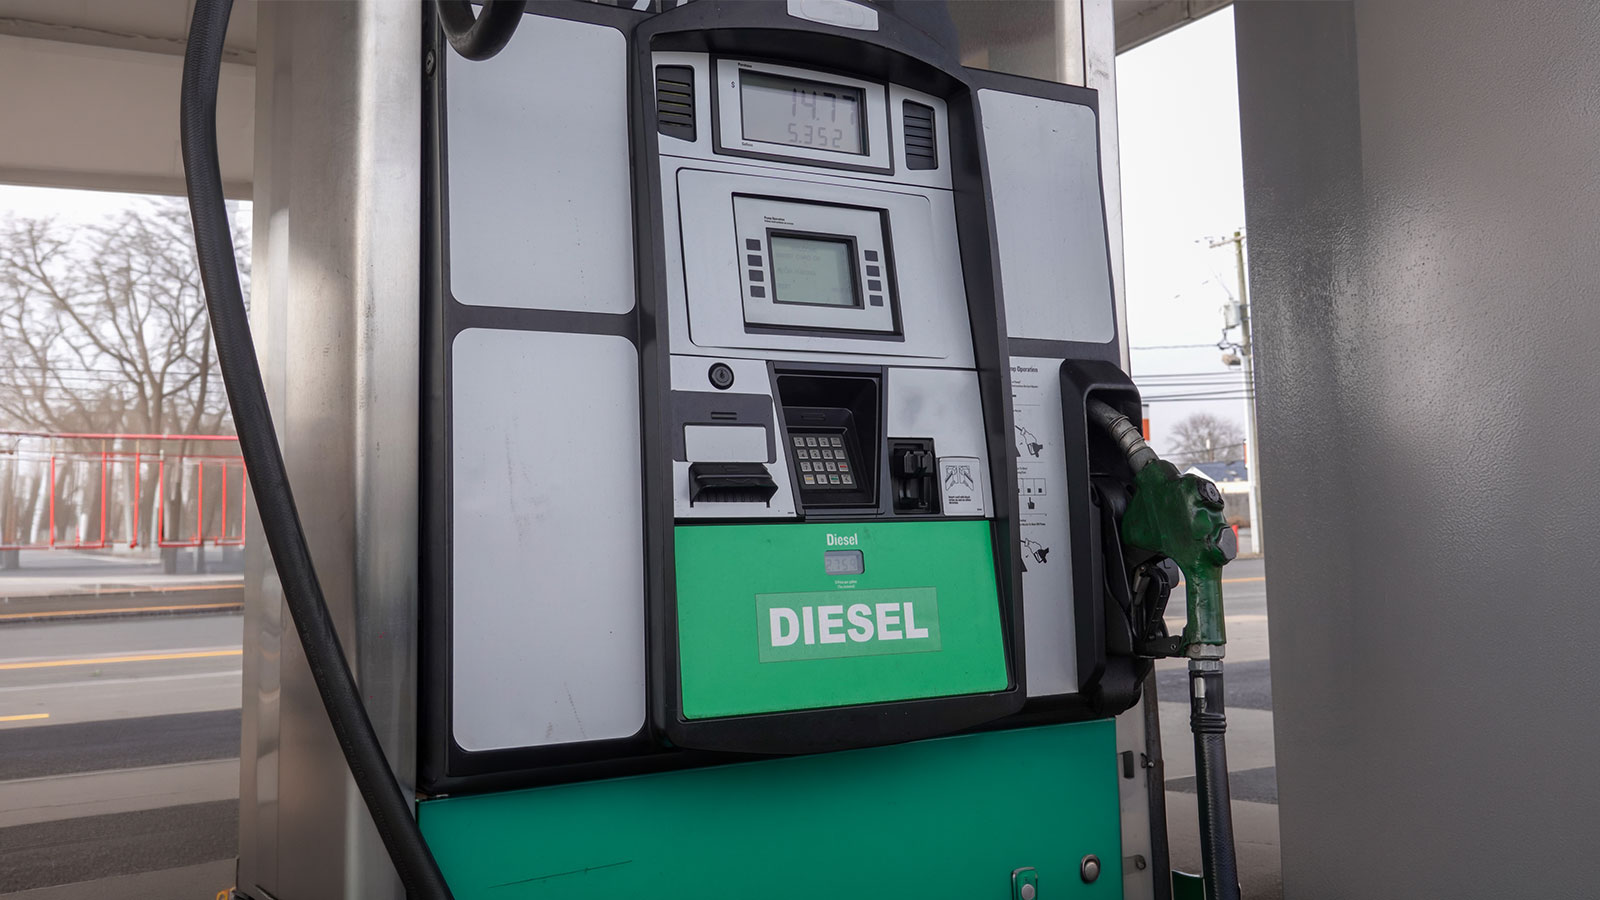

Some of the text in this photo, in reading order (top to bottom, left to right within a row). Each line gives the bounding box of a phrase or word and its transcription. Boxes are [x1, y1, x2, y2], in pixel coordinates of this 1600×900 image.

[792, 88, 856, 125] 14.77
[788, 122, 843, 148] 5.352
[826, 533, 858, 546] Diesel
[769, 602, 929, 647] DIESEL
